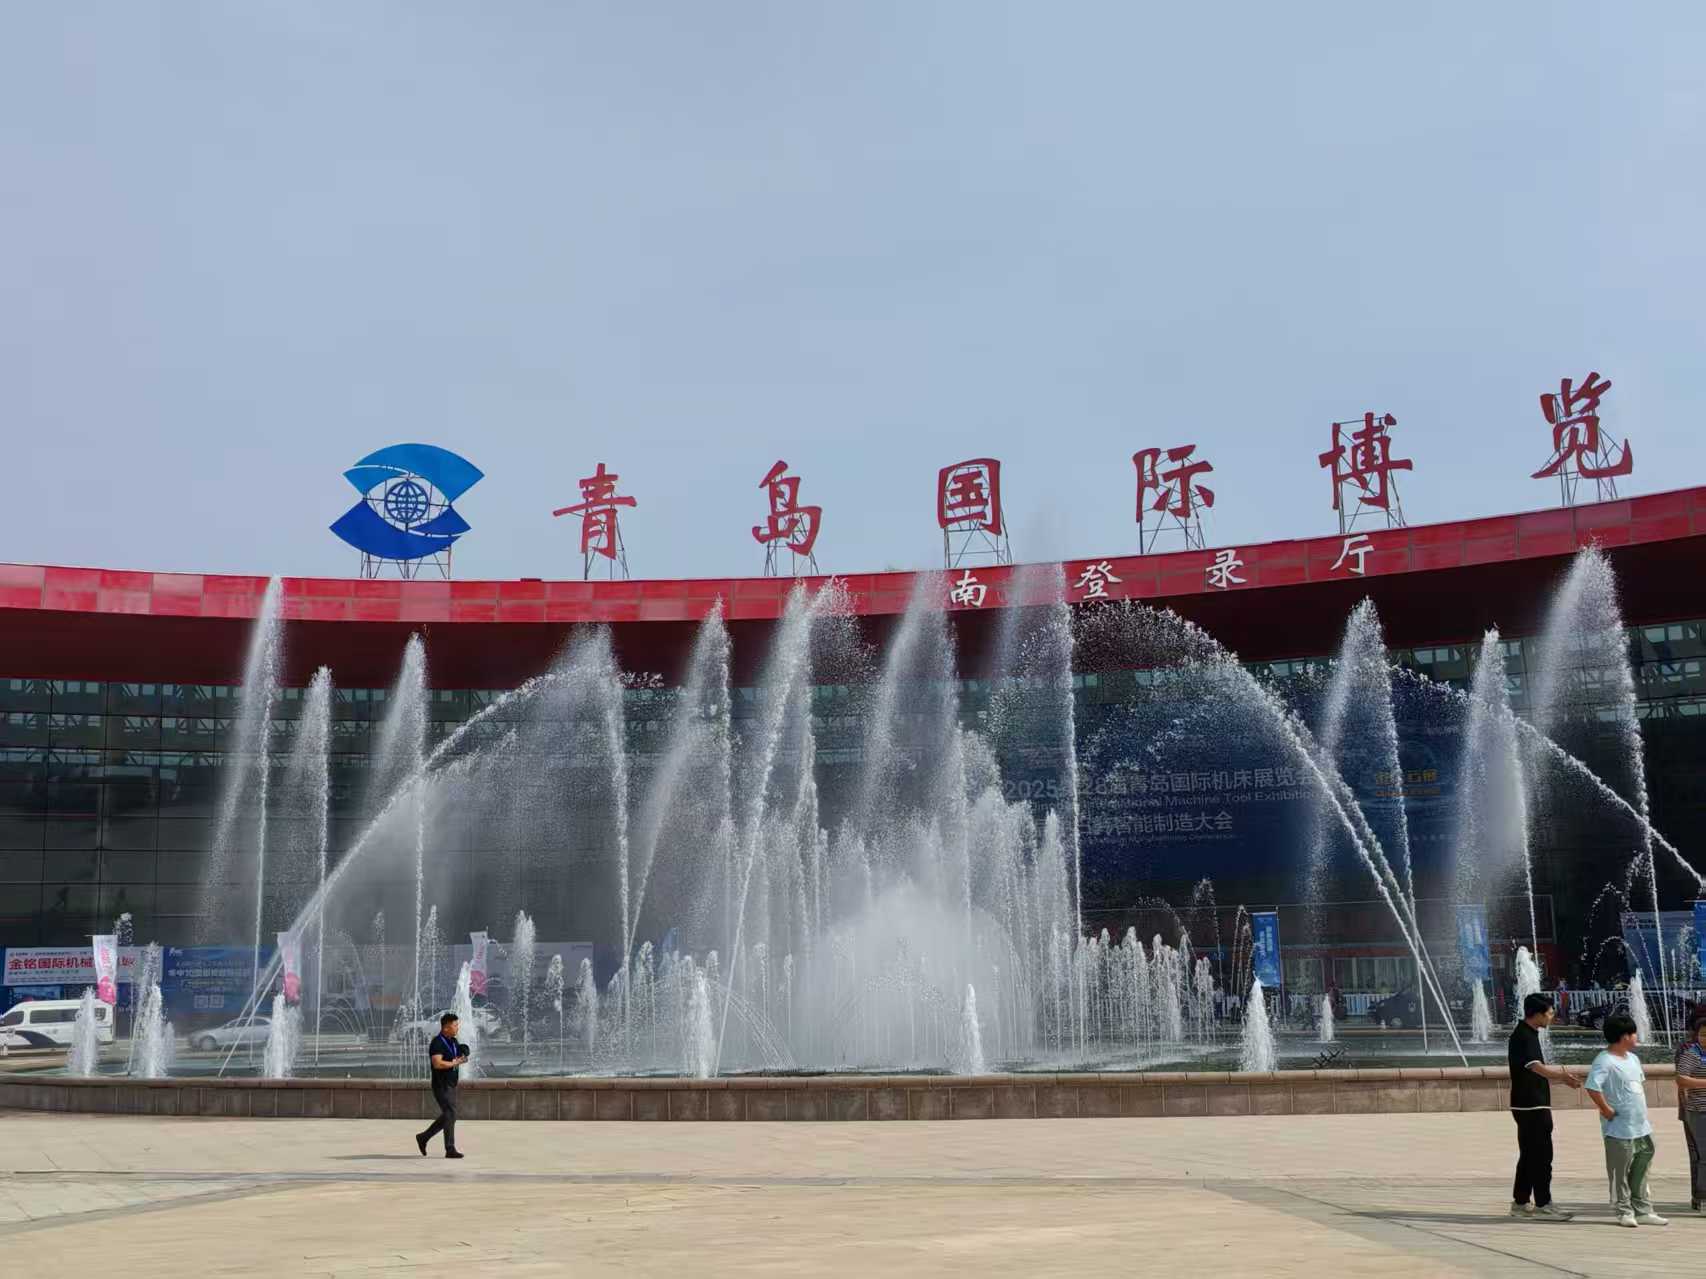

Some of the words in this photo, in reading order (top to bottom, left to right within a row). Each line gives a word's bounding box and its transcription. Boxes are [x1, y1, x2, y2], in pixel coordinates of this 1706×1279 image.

[553, 371, 1633, 560] 青岛国际博览
[950, 534, 1375, 607] 南登录厅
